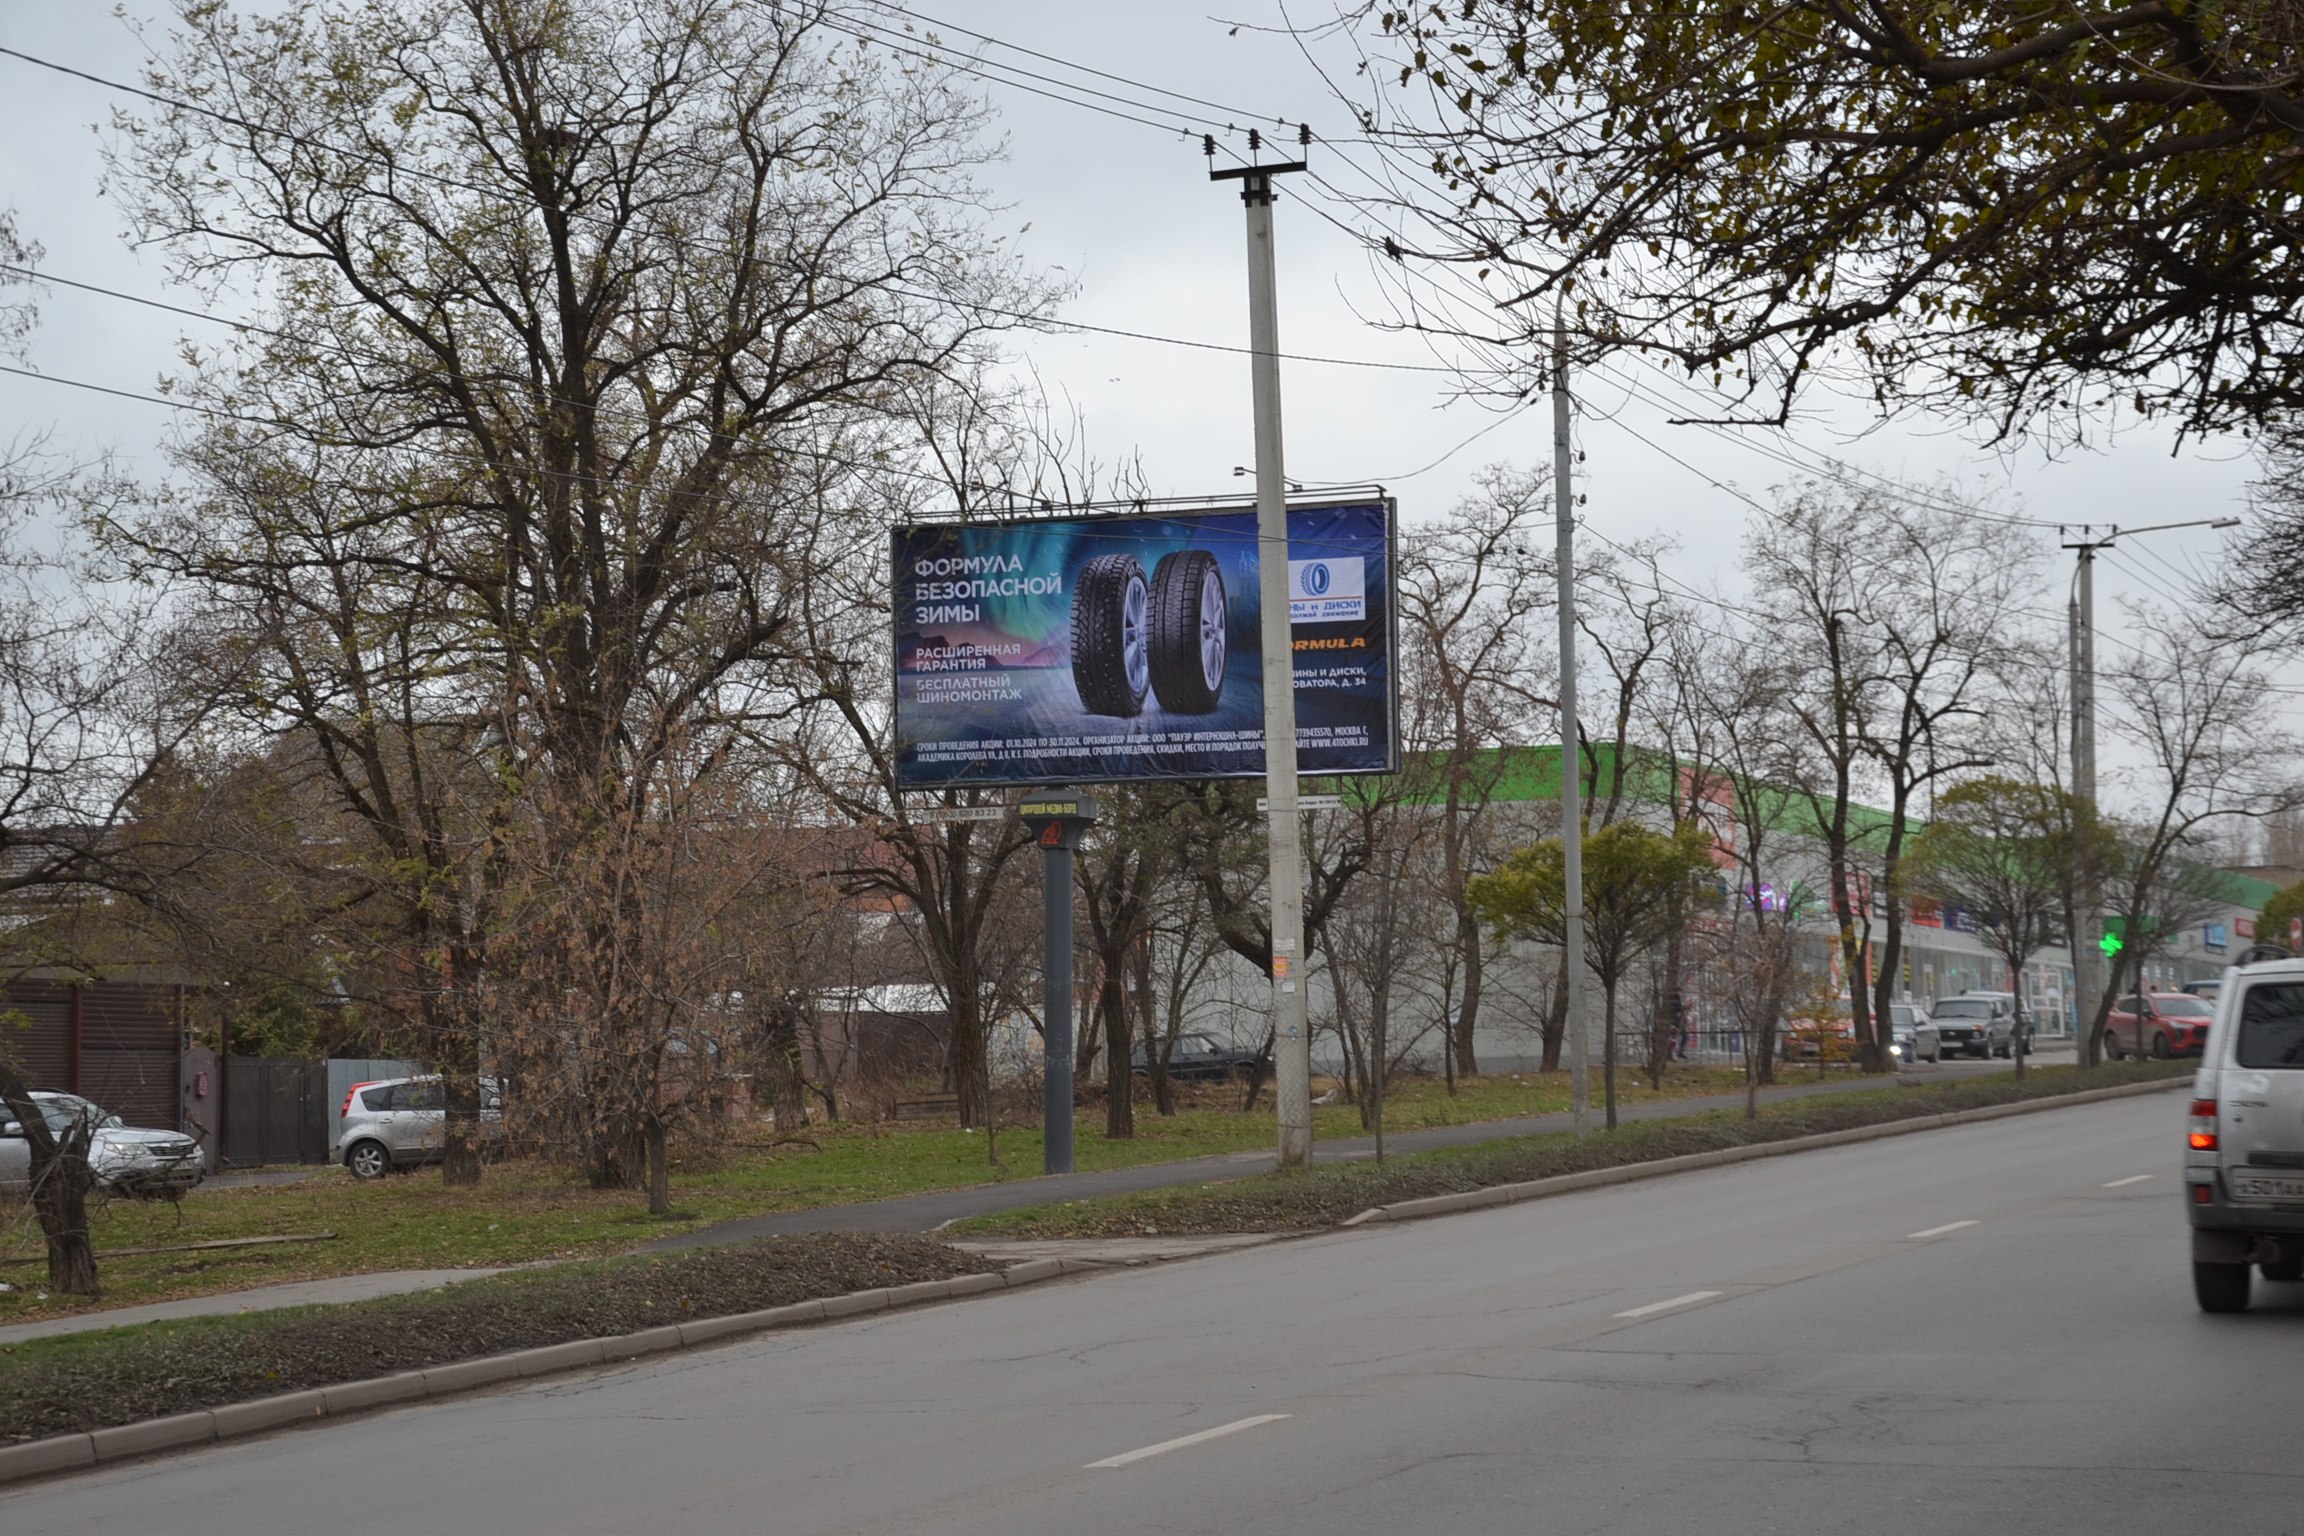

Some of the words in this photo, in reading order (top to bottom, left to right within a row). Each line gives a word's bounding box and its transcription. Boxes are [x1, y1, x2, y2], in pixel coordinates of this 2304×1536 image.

[915, 554, 1023, 577] ФОРМУЛА
[916, 572, 1061, 600] БЕЗОПАСНОЙ
[1324, 600, 1361, 610] ДИСКИ
[916, 604, 980, 625] ЗИМЫ
[1289, 637, 1366, 650] RMULA
[916, 644, 1021, 659] РАСШИРЕННАЯ
[916, 658, 986, 672] ГАРАНТИЯ
[1320, 668, 1326, 677] И
[1329, 666, 1367, 678] ДИСКИ,
[917, 673, 1010, 690] БЕСПЛАТНЫЙ
[1292, 678, 1339, 688] ОВАТОРА,
[1354, 677, 1366, 686] 34
[917, 689, 1022, 703] ШИНОМОНТАЖ
[917, 742, 937, 752] СРОКИ
[938, 740, 979, 751] ПРОВЕДЕНИЯ
[1083, 735, 1125, 745] ОРГАНИЗАТОР
[1152, 733, 1166, 743] ООО
[1334, 726, 1361, 735] МОСКВА
[917, 752, 955, 763] АКАДЕМИКА
[1023, 748, 1067, 759] ПОДРОБНОСТИ
[1092, 746, 1112, 756] СРОКИ
[1185, 742, 1205, 753] МЕСТО
[1211, 741, 1242, 752] ПОРЯДОК
